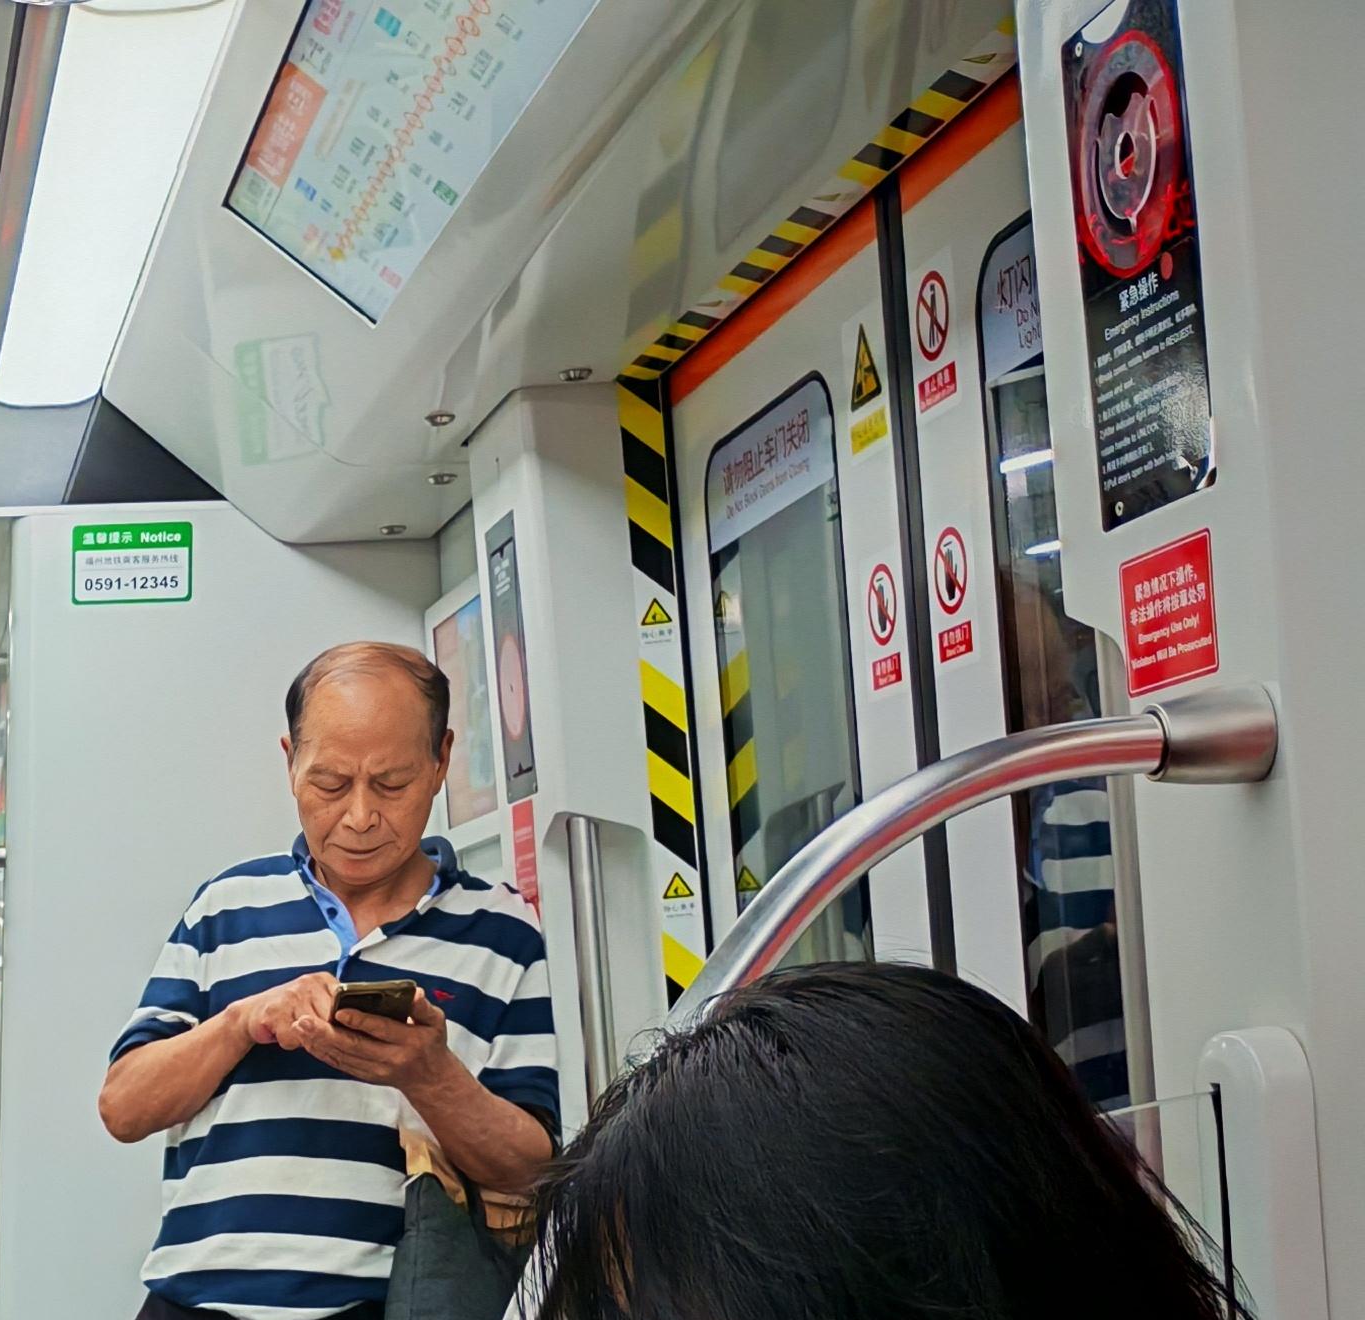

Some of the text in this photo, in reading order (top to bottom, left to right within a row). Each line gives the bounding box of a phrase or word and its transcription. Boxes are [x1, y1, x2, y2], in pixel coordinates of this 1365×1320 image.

[1104, 312, 1140, 342] Emergency
[723, 408, 810, 496] 请勿阻止车门关闭
[140, 530, 182, 543] Notice
[84, 575, 179, 591] 0591-12345
